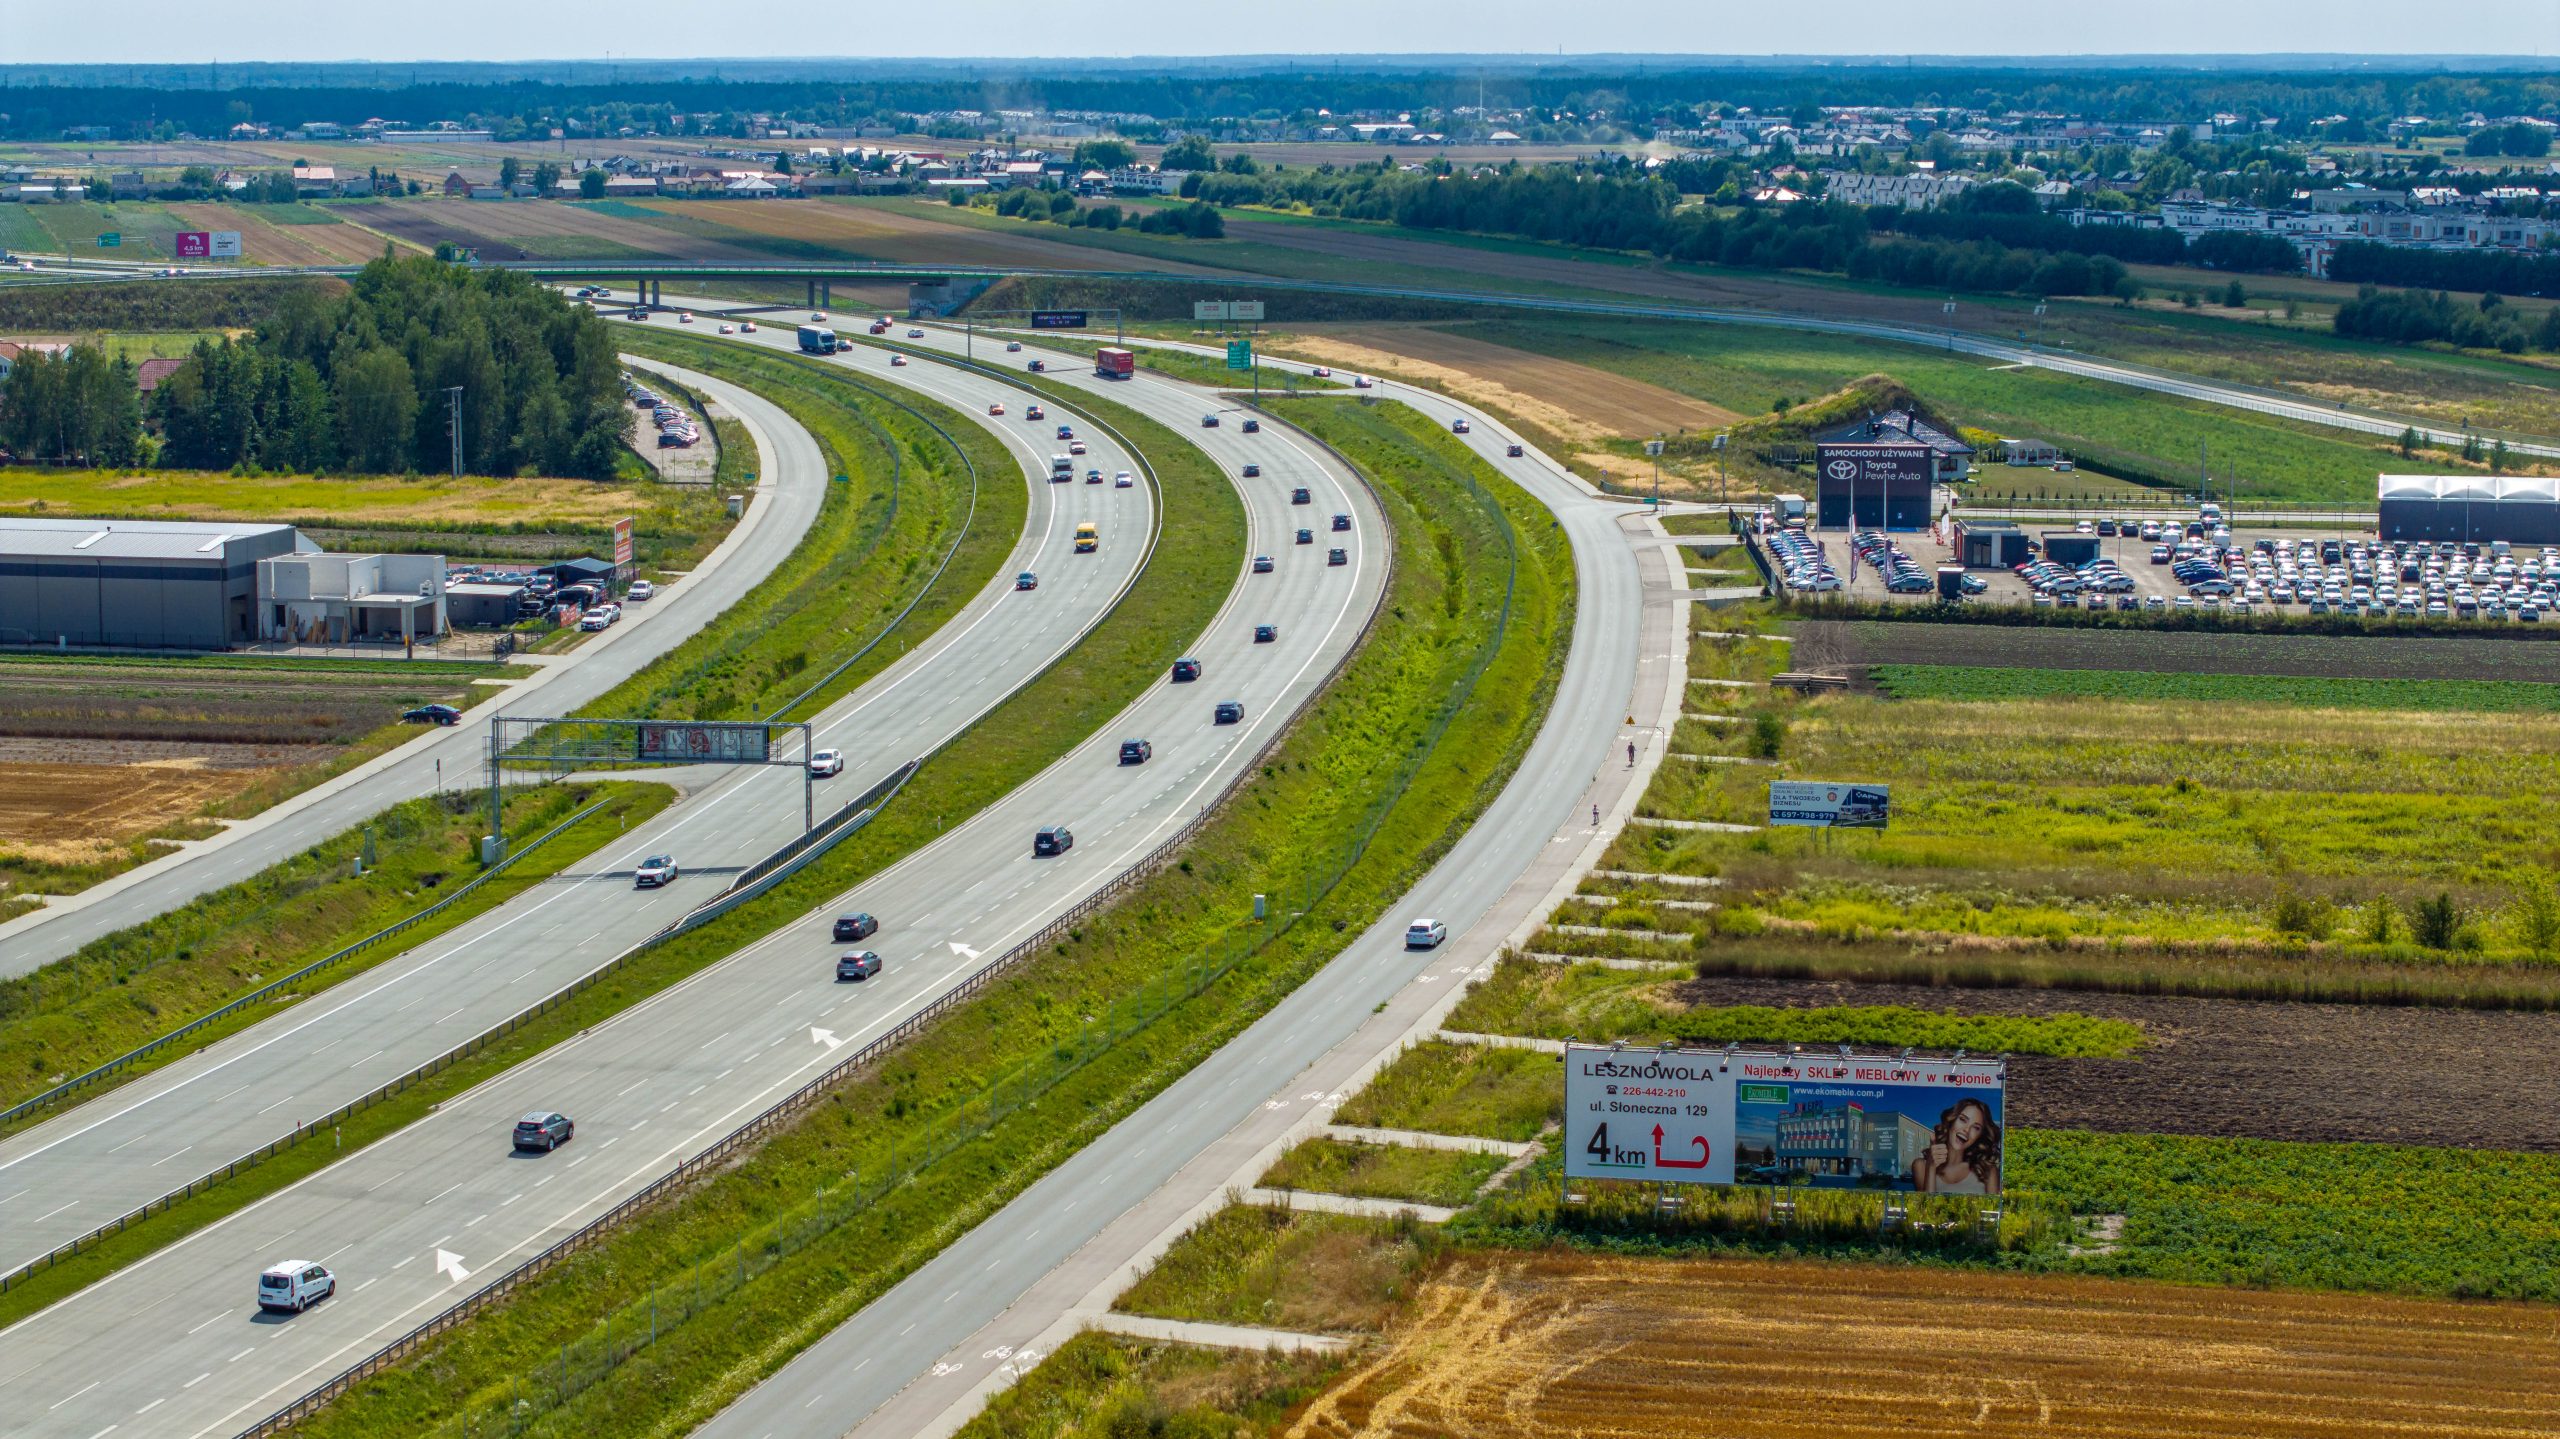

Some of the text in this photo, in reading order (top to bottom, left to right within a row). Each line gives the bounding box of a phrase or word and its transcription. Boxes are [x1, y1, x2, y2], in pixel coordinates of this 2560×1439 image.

[1824, 448, 1925, 458] SAMOCHODY UŻYWANE
[1865, 460, 1897, 470] Toyota
[1865, 471, 1921, 480] Pewne Auto
[1781, 811, 1835, 819] 697-798-979
[1583, 1064, 1714, 1081] LESZNOWOLA
[1807, 1066, 1849, 1079] SKLEP
[1855, 1068, 1920, 1082] MEBLOWY
[1926, 1073, 1937, 1082] w
[1943, 1072, 1992, 1086] rgionie
[1623, 1086, 1686, 1097] 226-442-210
[1793, 1087, 1884, 1099] www.ekomeble.com.pl
[1590, 1101, 1708, 1116] ul. Słoneczna 129
[1587, 1122, 1646, 1164] 4 km
